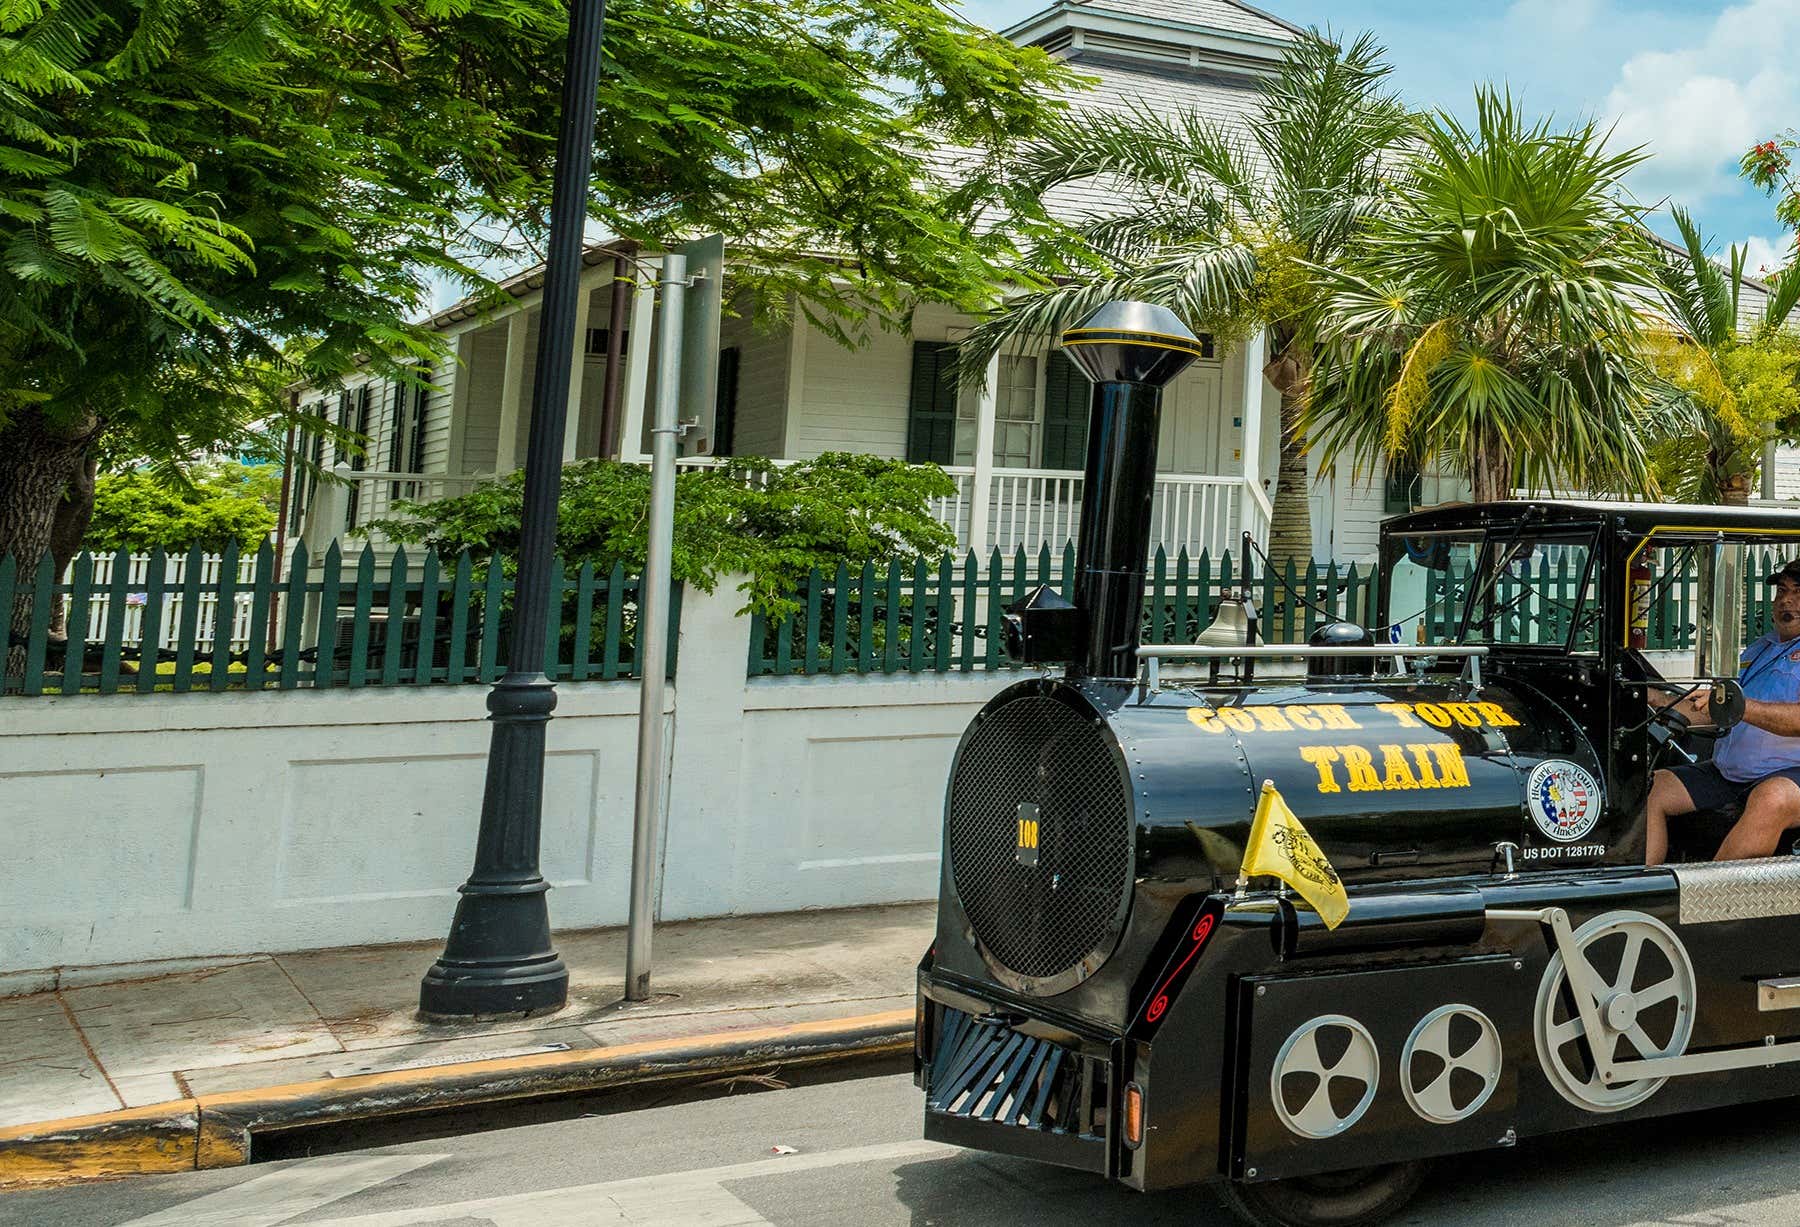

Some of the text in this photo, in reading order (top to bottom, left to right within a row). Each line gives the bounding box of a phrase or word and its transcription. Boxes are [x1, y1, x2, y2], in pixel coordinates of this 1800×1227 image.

[1187, 701, 1521, 733] CONCH TOUR
[1300, 743, 1471, 794] TRAIN
[1531, 765, 1594, 800] Historic Tours
[1018, 819, 1037, 849] 108
[1553, 817, 1590, 836] America
[1523, 845, 1605, 859] US DOT 1281776
